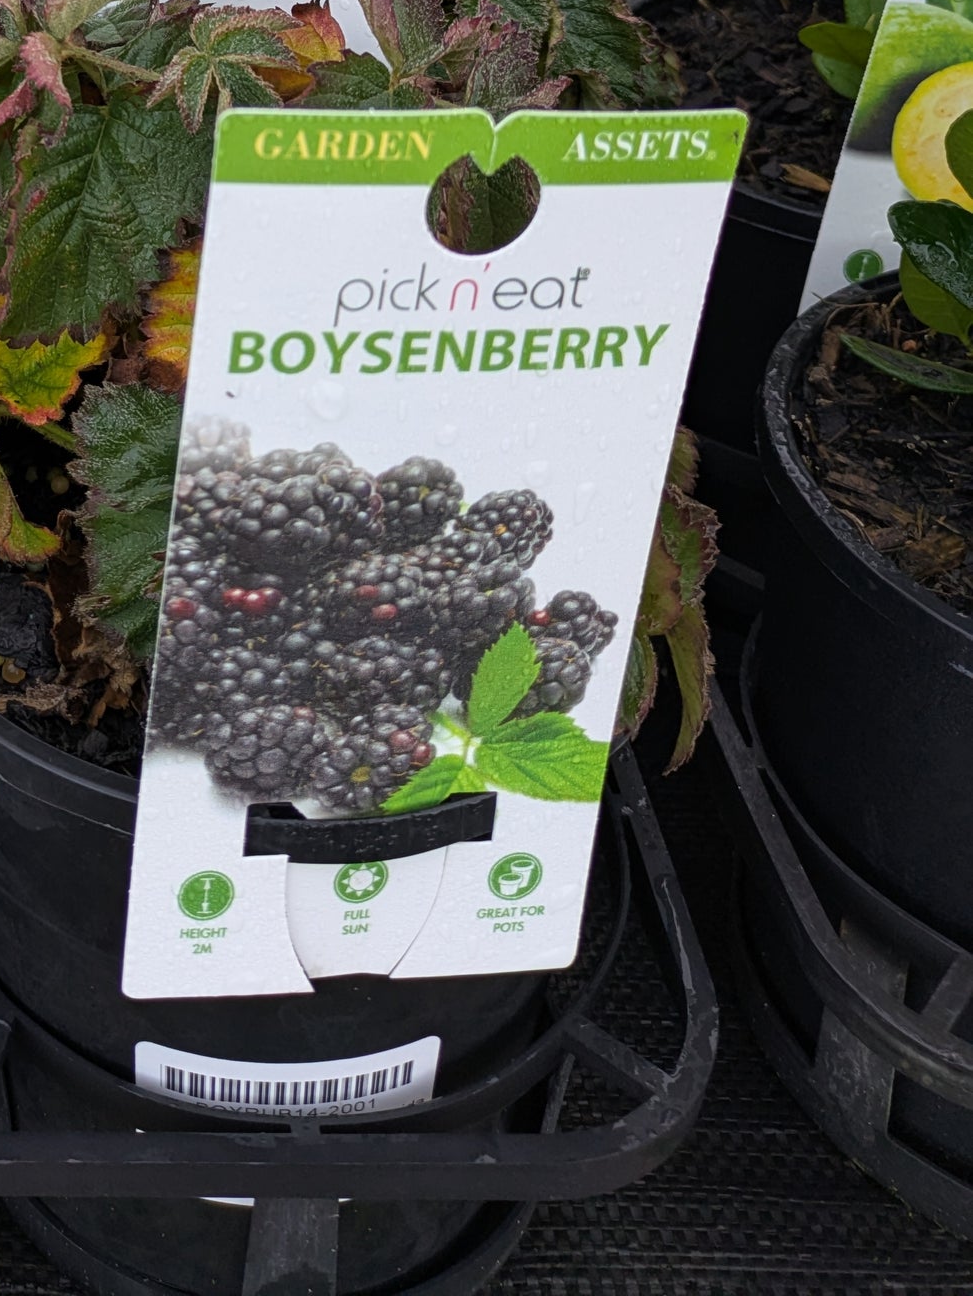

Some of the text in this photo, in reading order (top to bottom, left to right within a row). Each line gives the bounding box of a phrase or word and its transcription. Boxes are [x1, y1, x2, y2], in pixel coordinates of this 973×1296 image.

[253, 128, 711, 162] GARDEN ASSETS
[333, 262, 439, 328] pick
[492, 266, 590, 310] eat
[227, 323, 671, 375] BOYSENBERRY
[343, 909, 372, 921] FULL
[476, 904, 546, 920] GREAT FOR
[179, 926, 228, 941] HEIGHT
[341, 923, 369, 936] SUN
[492, 920, 525, 934] POTS
[192, 943, 213, 955] 2M
